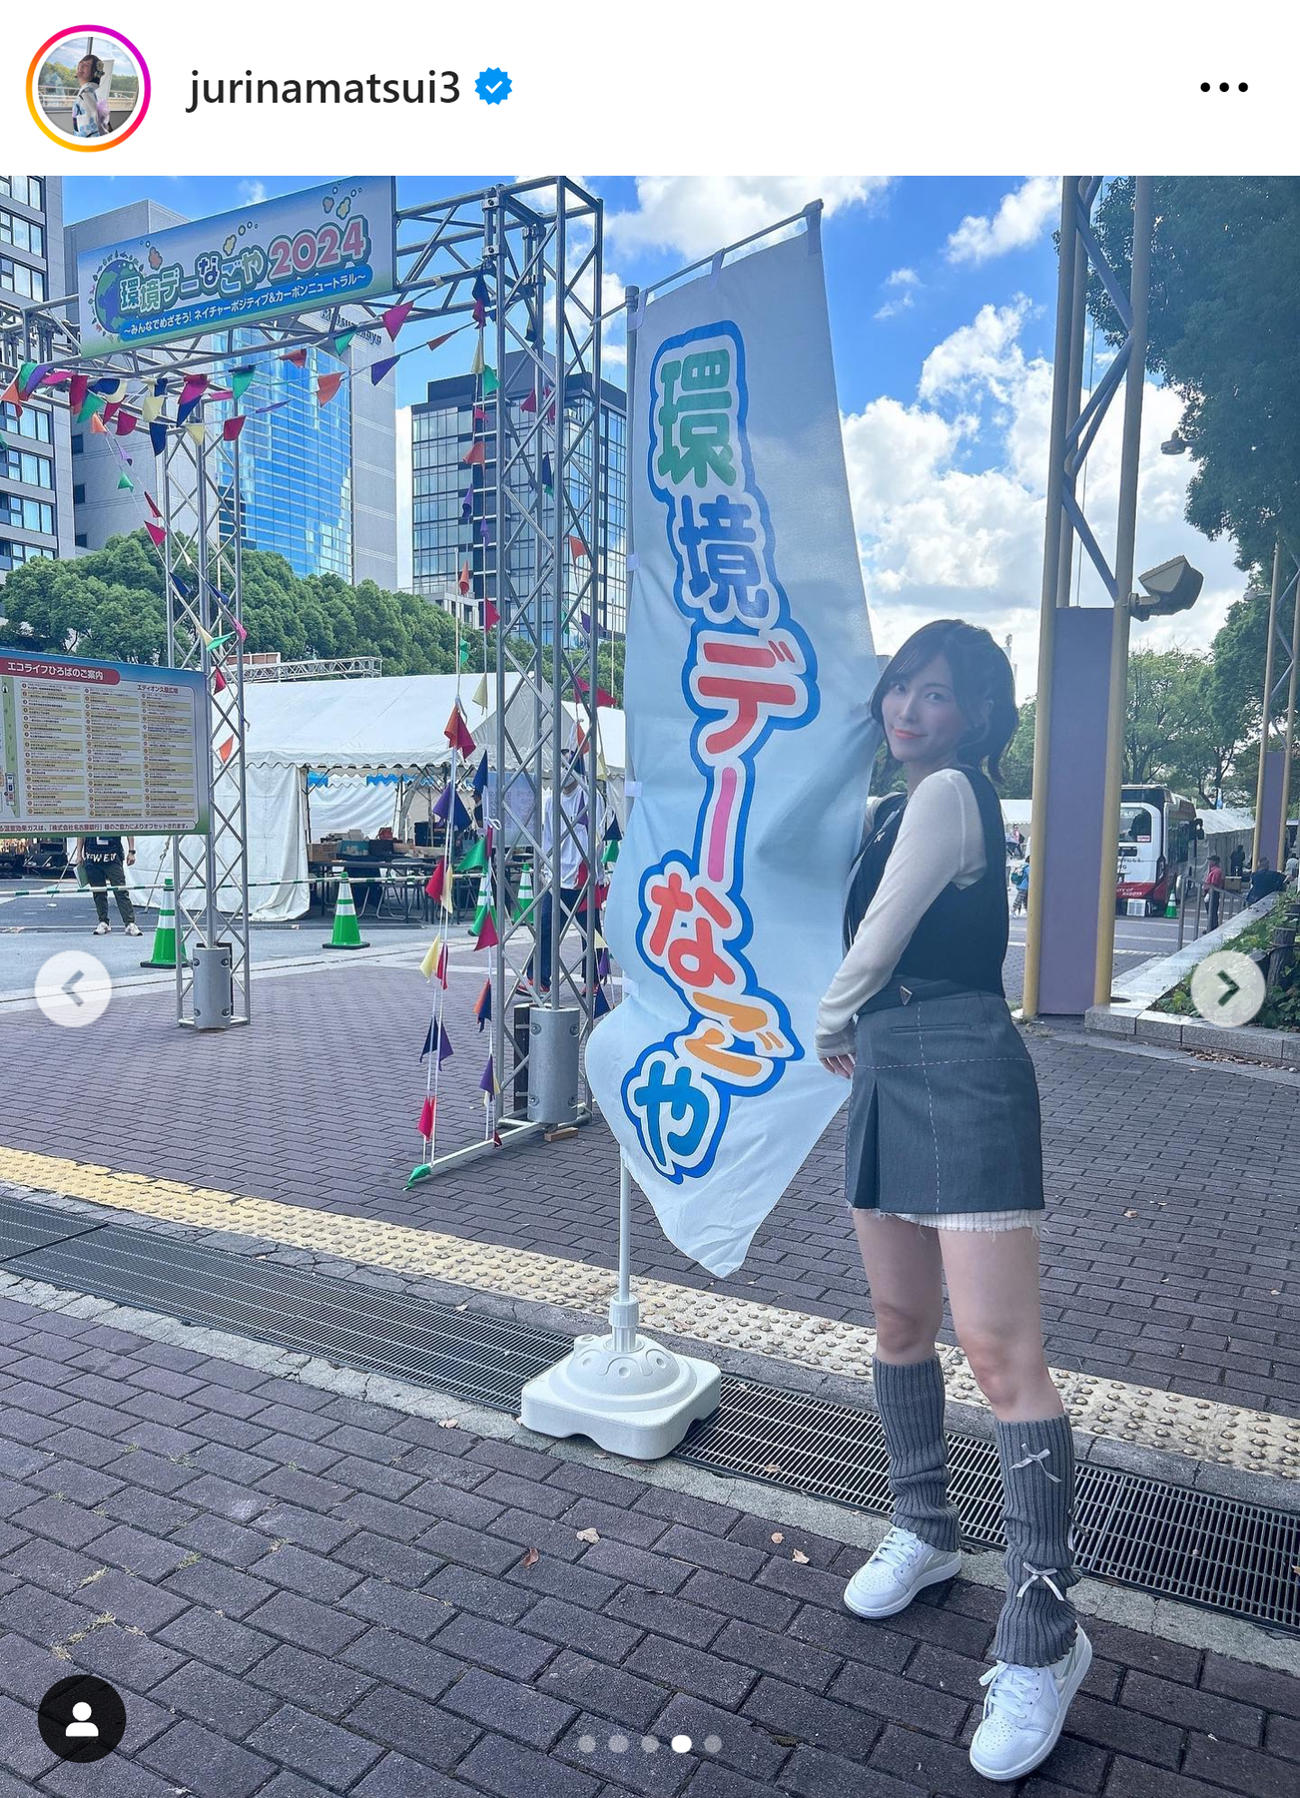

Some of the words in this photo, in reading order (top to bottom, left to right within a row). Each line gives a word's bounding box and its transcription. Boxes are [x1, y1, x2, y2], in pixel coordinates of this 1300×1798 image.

[8, 661, 104, 680] エコライフひろばのご案内
[631, 344, 799, 1169] 環境デーなごや
